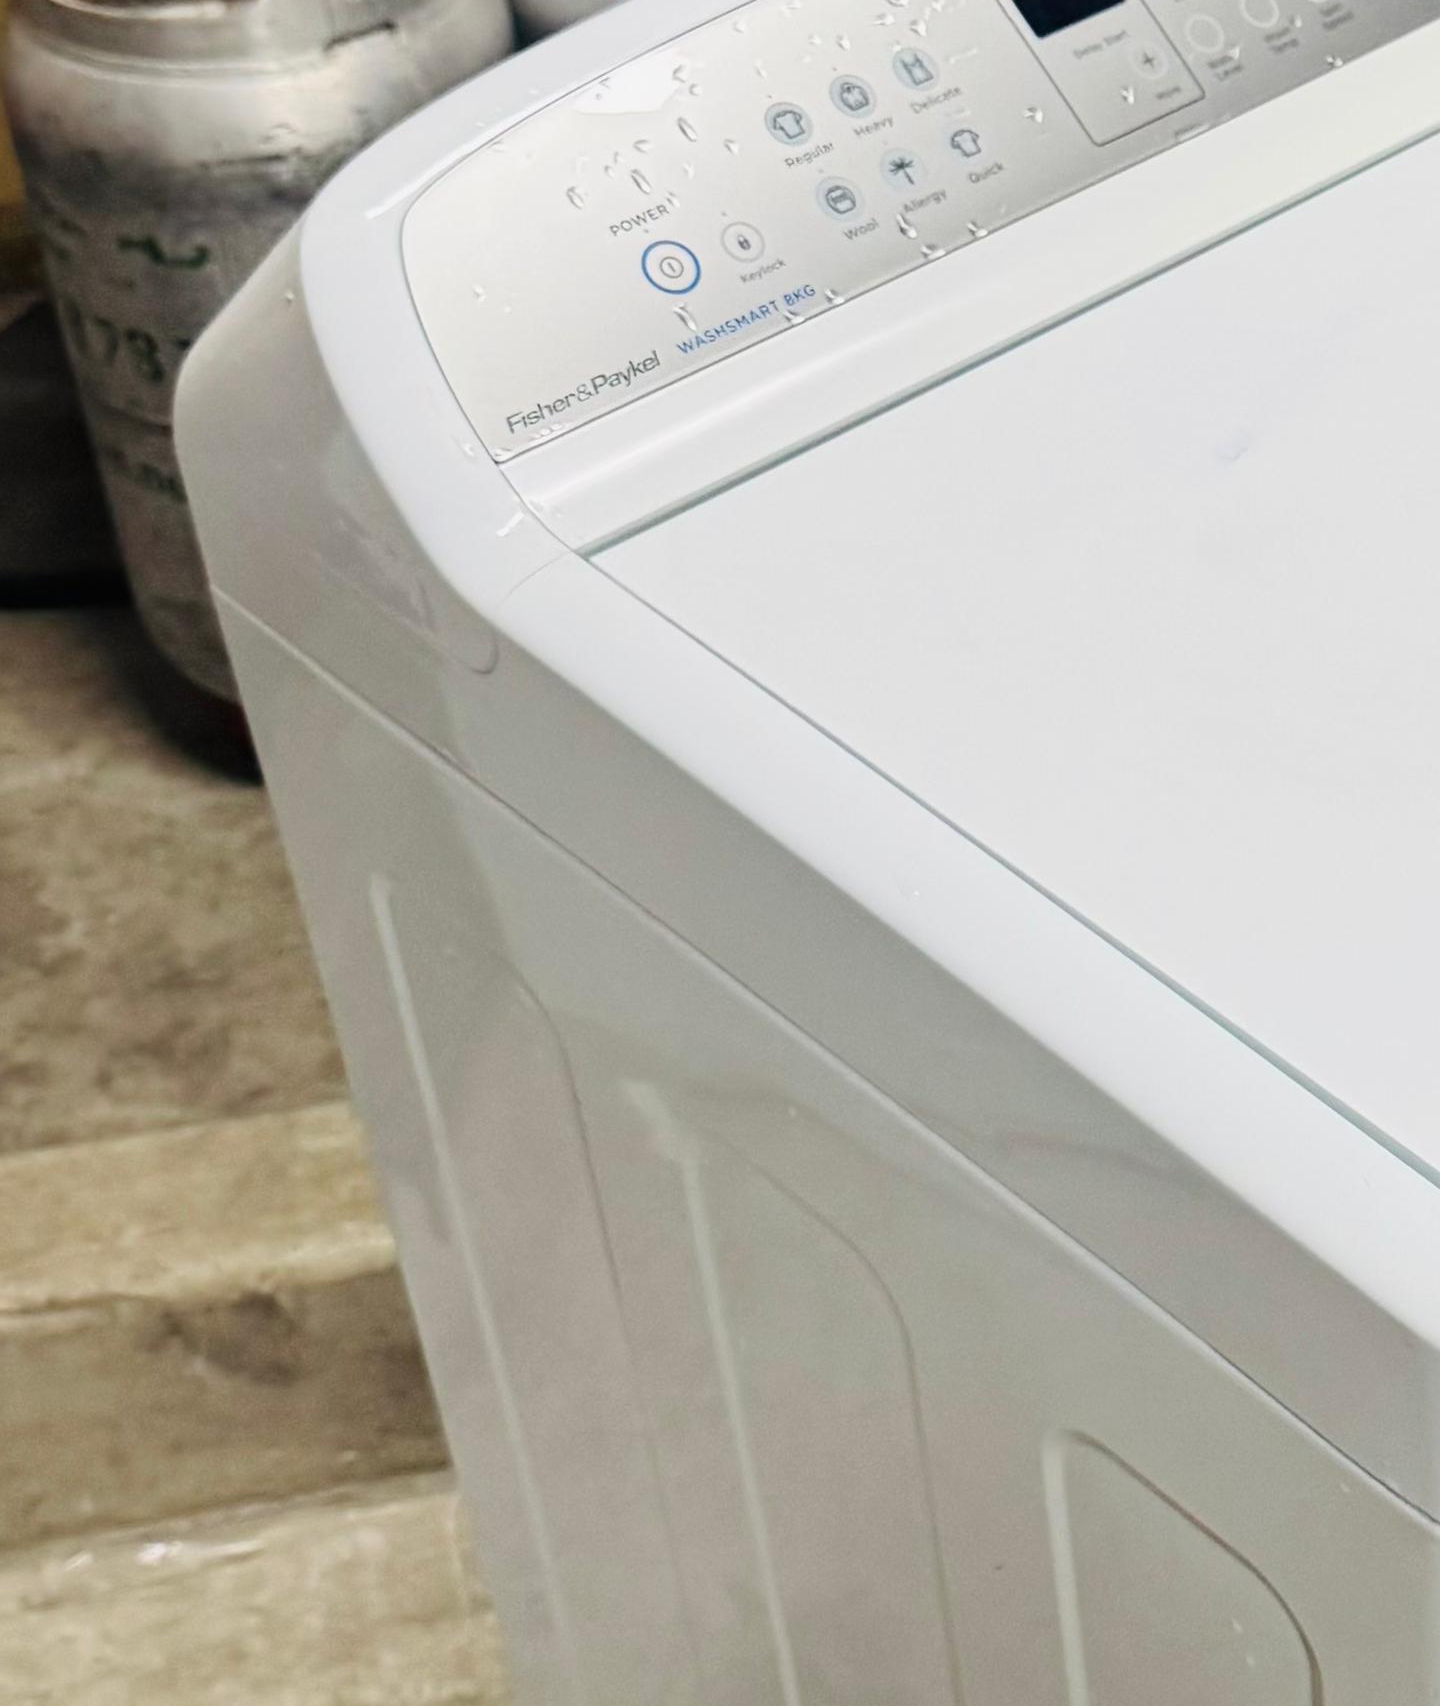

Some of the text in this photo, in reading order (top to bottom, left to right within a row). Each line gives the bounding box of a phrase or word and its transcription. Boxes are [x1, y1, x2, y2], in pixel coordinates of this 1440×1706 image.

[853, 116, 894, 137] Heavy
[784, 142, 834, 168] Regular
[968, 162, 1004, 184] Quick
[609, 204, 669, 237] POWER
[843, 217, 879, 240] Wool
[740, 258, 786, 284] Keylock
[676, 284, 816, 355] WASHSMART 8KG
[506, 350, 661, 434] Fisher&Paykel
